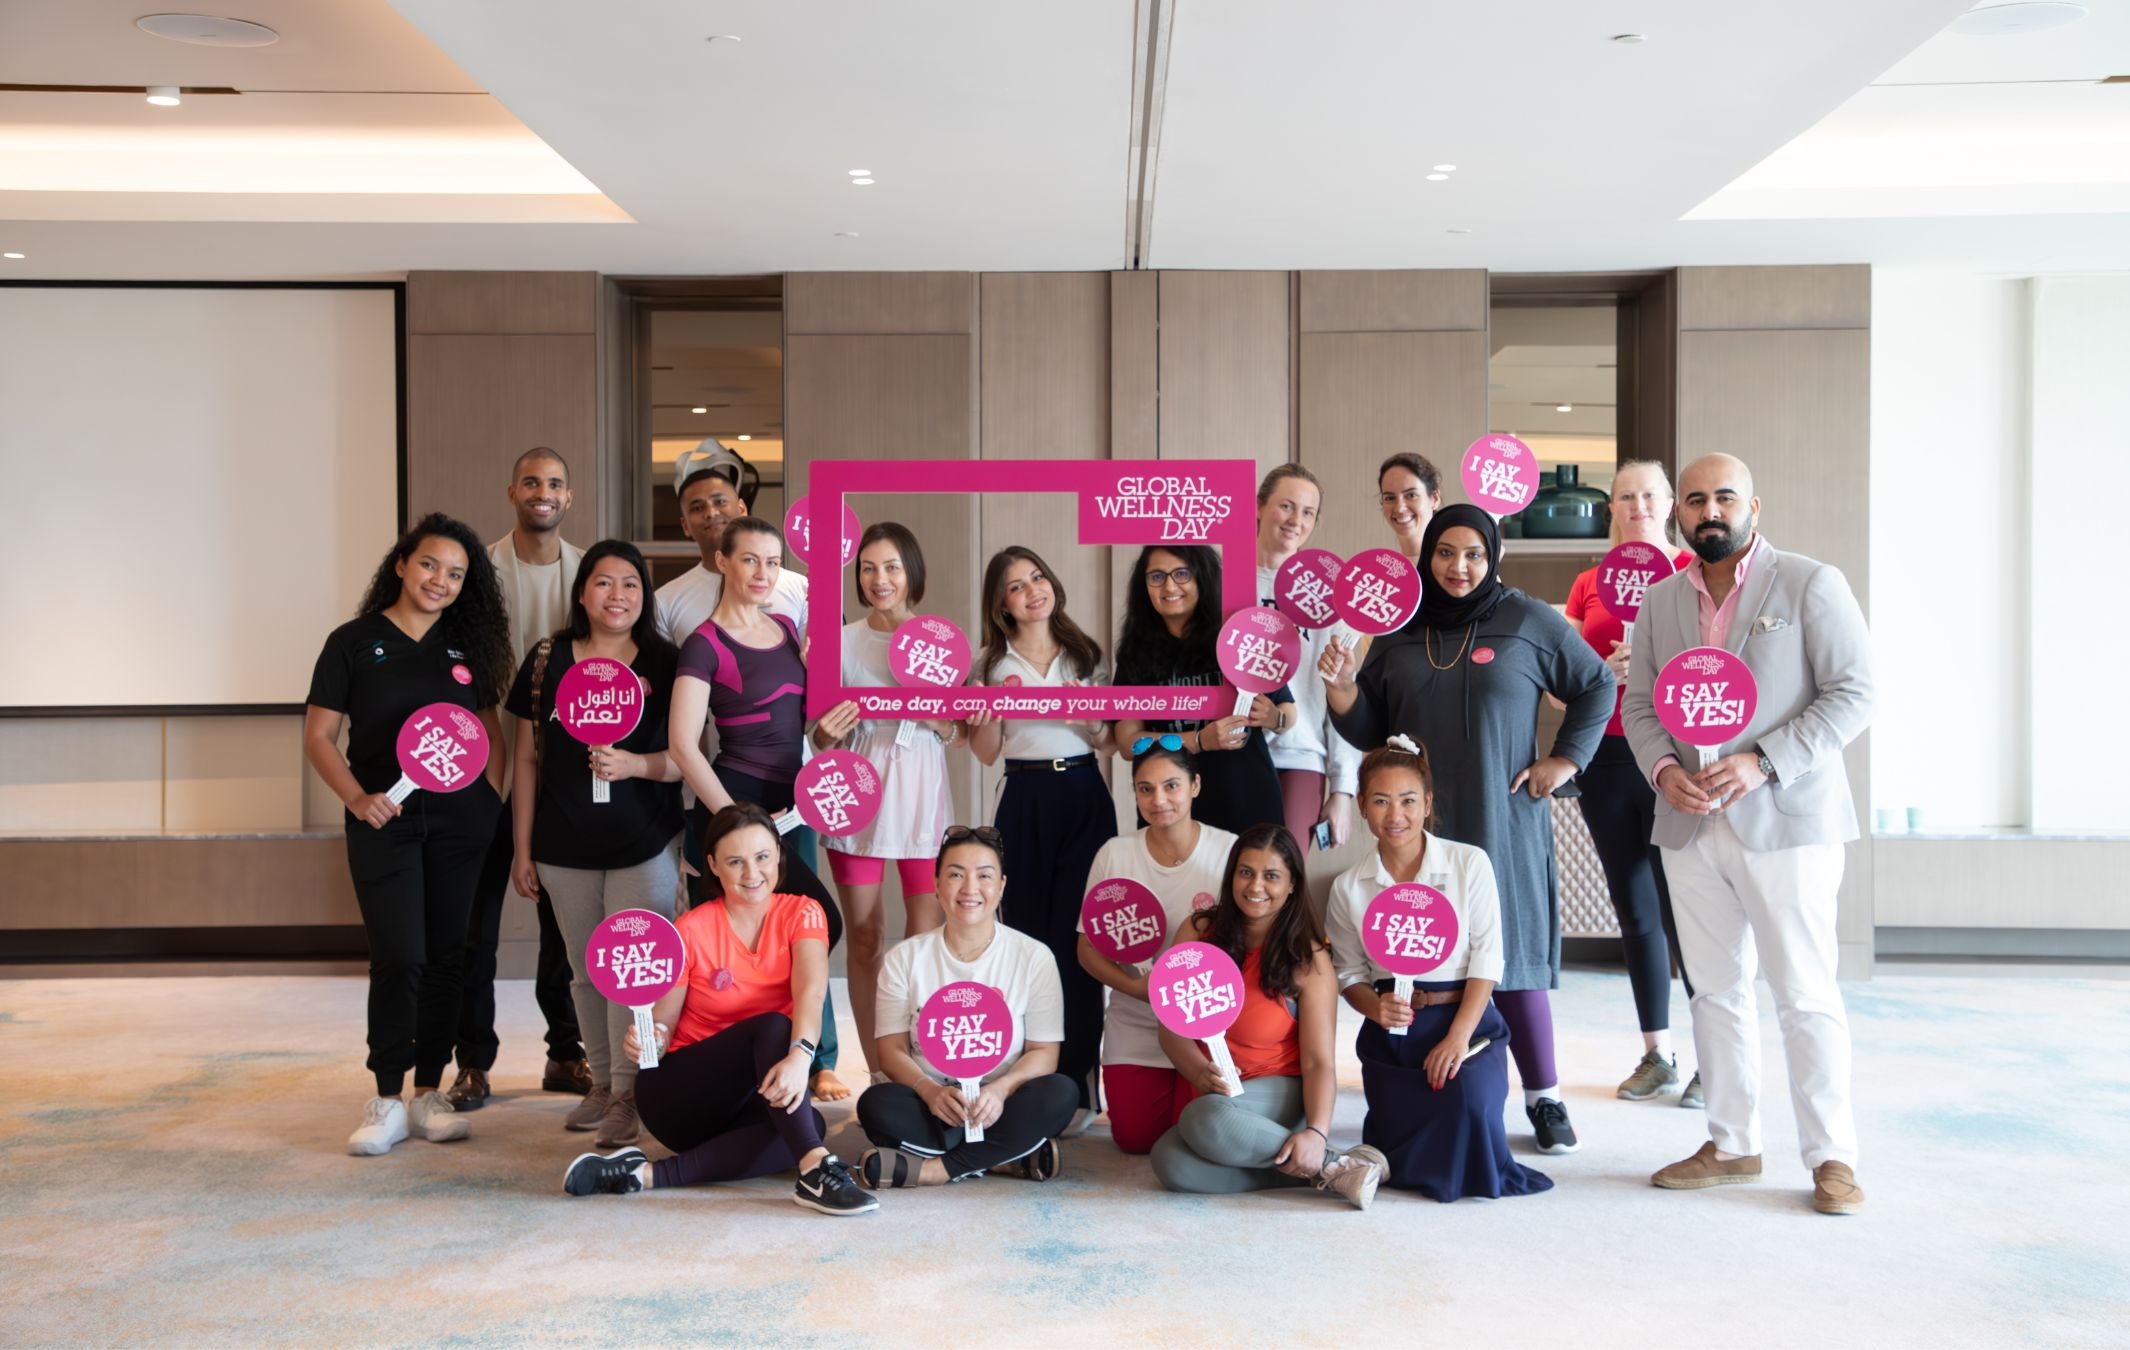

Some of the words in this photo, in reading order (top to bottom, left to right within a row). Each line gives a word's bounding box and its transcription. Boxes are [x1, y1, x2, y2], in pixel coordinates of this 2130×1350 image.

[1470, 456, 1480, 471] I
[1482, 459, 1520, 480] SAY
[1117, 477, 1211, 496] GLOBAL
[1479, 472, 1529, 504] YES!
[1095, 496, 1232, 518] WELLNESS
[1160, 518, 1216, 540] DAY
[1288, 562, 1303, 574] I
[1299, 570, 1333, 600] SAY
[1346, 566, 1361, 581] I
[1358, 573, 1400, 600] SAY
[1603, 568, 1613, 583] I
[1616, 569, 1655, 586] SAY
[1285, 579, 1334, 624] YES!
[1347, 586, 1402, 626] YES!
[1615, 584, 1647, 606] YE
[898, 635, 910, 650] I
[910, 639, 952, 663] SAY
[1227, 629, 1240, 645] I
[1240, 633, 1282, 657] SAY
[905, 654, 959, 687] YES!
[1234, 648, 1288, 683] YES!
[1681, 660, 1724, 670] WELLNESS
[1688, 655, 1718, 663] GLOBAL
[1703, 667, 1719, 675] DAY
[579, 687, 615, 708] أقول
[619, 687, 634, 704] أنا
[860, 696, 903, 711] "One
[907, 696, 947, 713] day,
[953, 699, 987, 710] can
[993, 696, 1061, 713] change
[1067, 699, 1107, 713] your
[1113, 696, 1167, 710] whole
[1171, 696, 1208, 710] life!"
[1665, 685, 1675, 704] I
[1681, 682, 1729, 702] SAY
[1680, 700, 1745, 727] YES!
[414, 716, 432, 731] I
[424, 727, 467, 760] SAY
[410, 735, 464, 787] YES!
[818, 759, 836, 771] I
[825, 772, 859, 807] SAY
[807, 776, 851, 831] YES!
[1394, 893, 1434, 904] WELLNESS
[1400, 889, 1429, 898] GLOBAL
[1412, 901, 1428, 910] DAY
[610, 920, 650, 932] WELLNESS
[616, 916, 645, 925] GLOBAL
[1091, 918, 1101, 935] I
[1103, 904, 1138, 930] SAY
[1372, 913, 1384, 930] I
[1386, 914, 1434, 935] SAY
[631, 928, 647, 936] DAY
[1107, 916, 1161, 950] YES!
[597, 948, 606, 967] I
[612, 942, 656, 964] SAY
[1385, 932, 1446, 960] YES!
[612, 958, 673, 989] YES!
[942, 993, 982, 1003] WELLNESS
[948, 988, 974, 996] GLOBAL
[1159, 987, 1170, 1006] I
[1173, 970, 1213, 1001] SAY
[962, 999, 977, 1007] DAY
[1176, 983, 1236, 1024] YES!
[927, 1019, 937, 1037] I
[942, 1014, 987, 1035] SAY
[942, 1031, 1002, 1060] YES!
